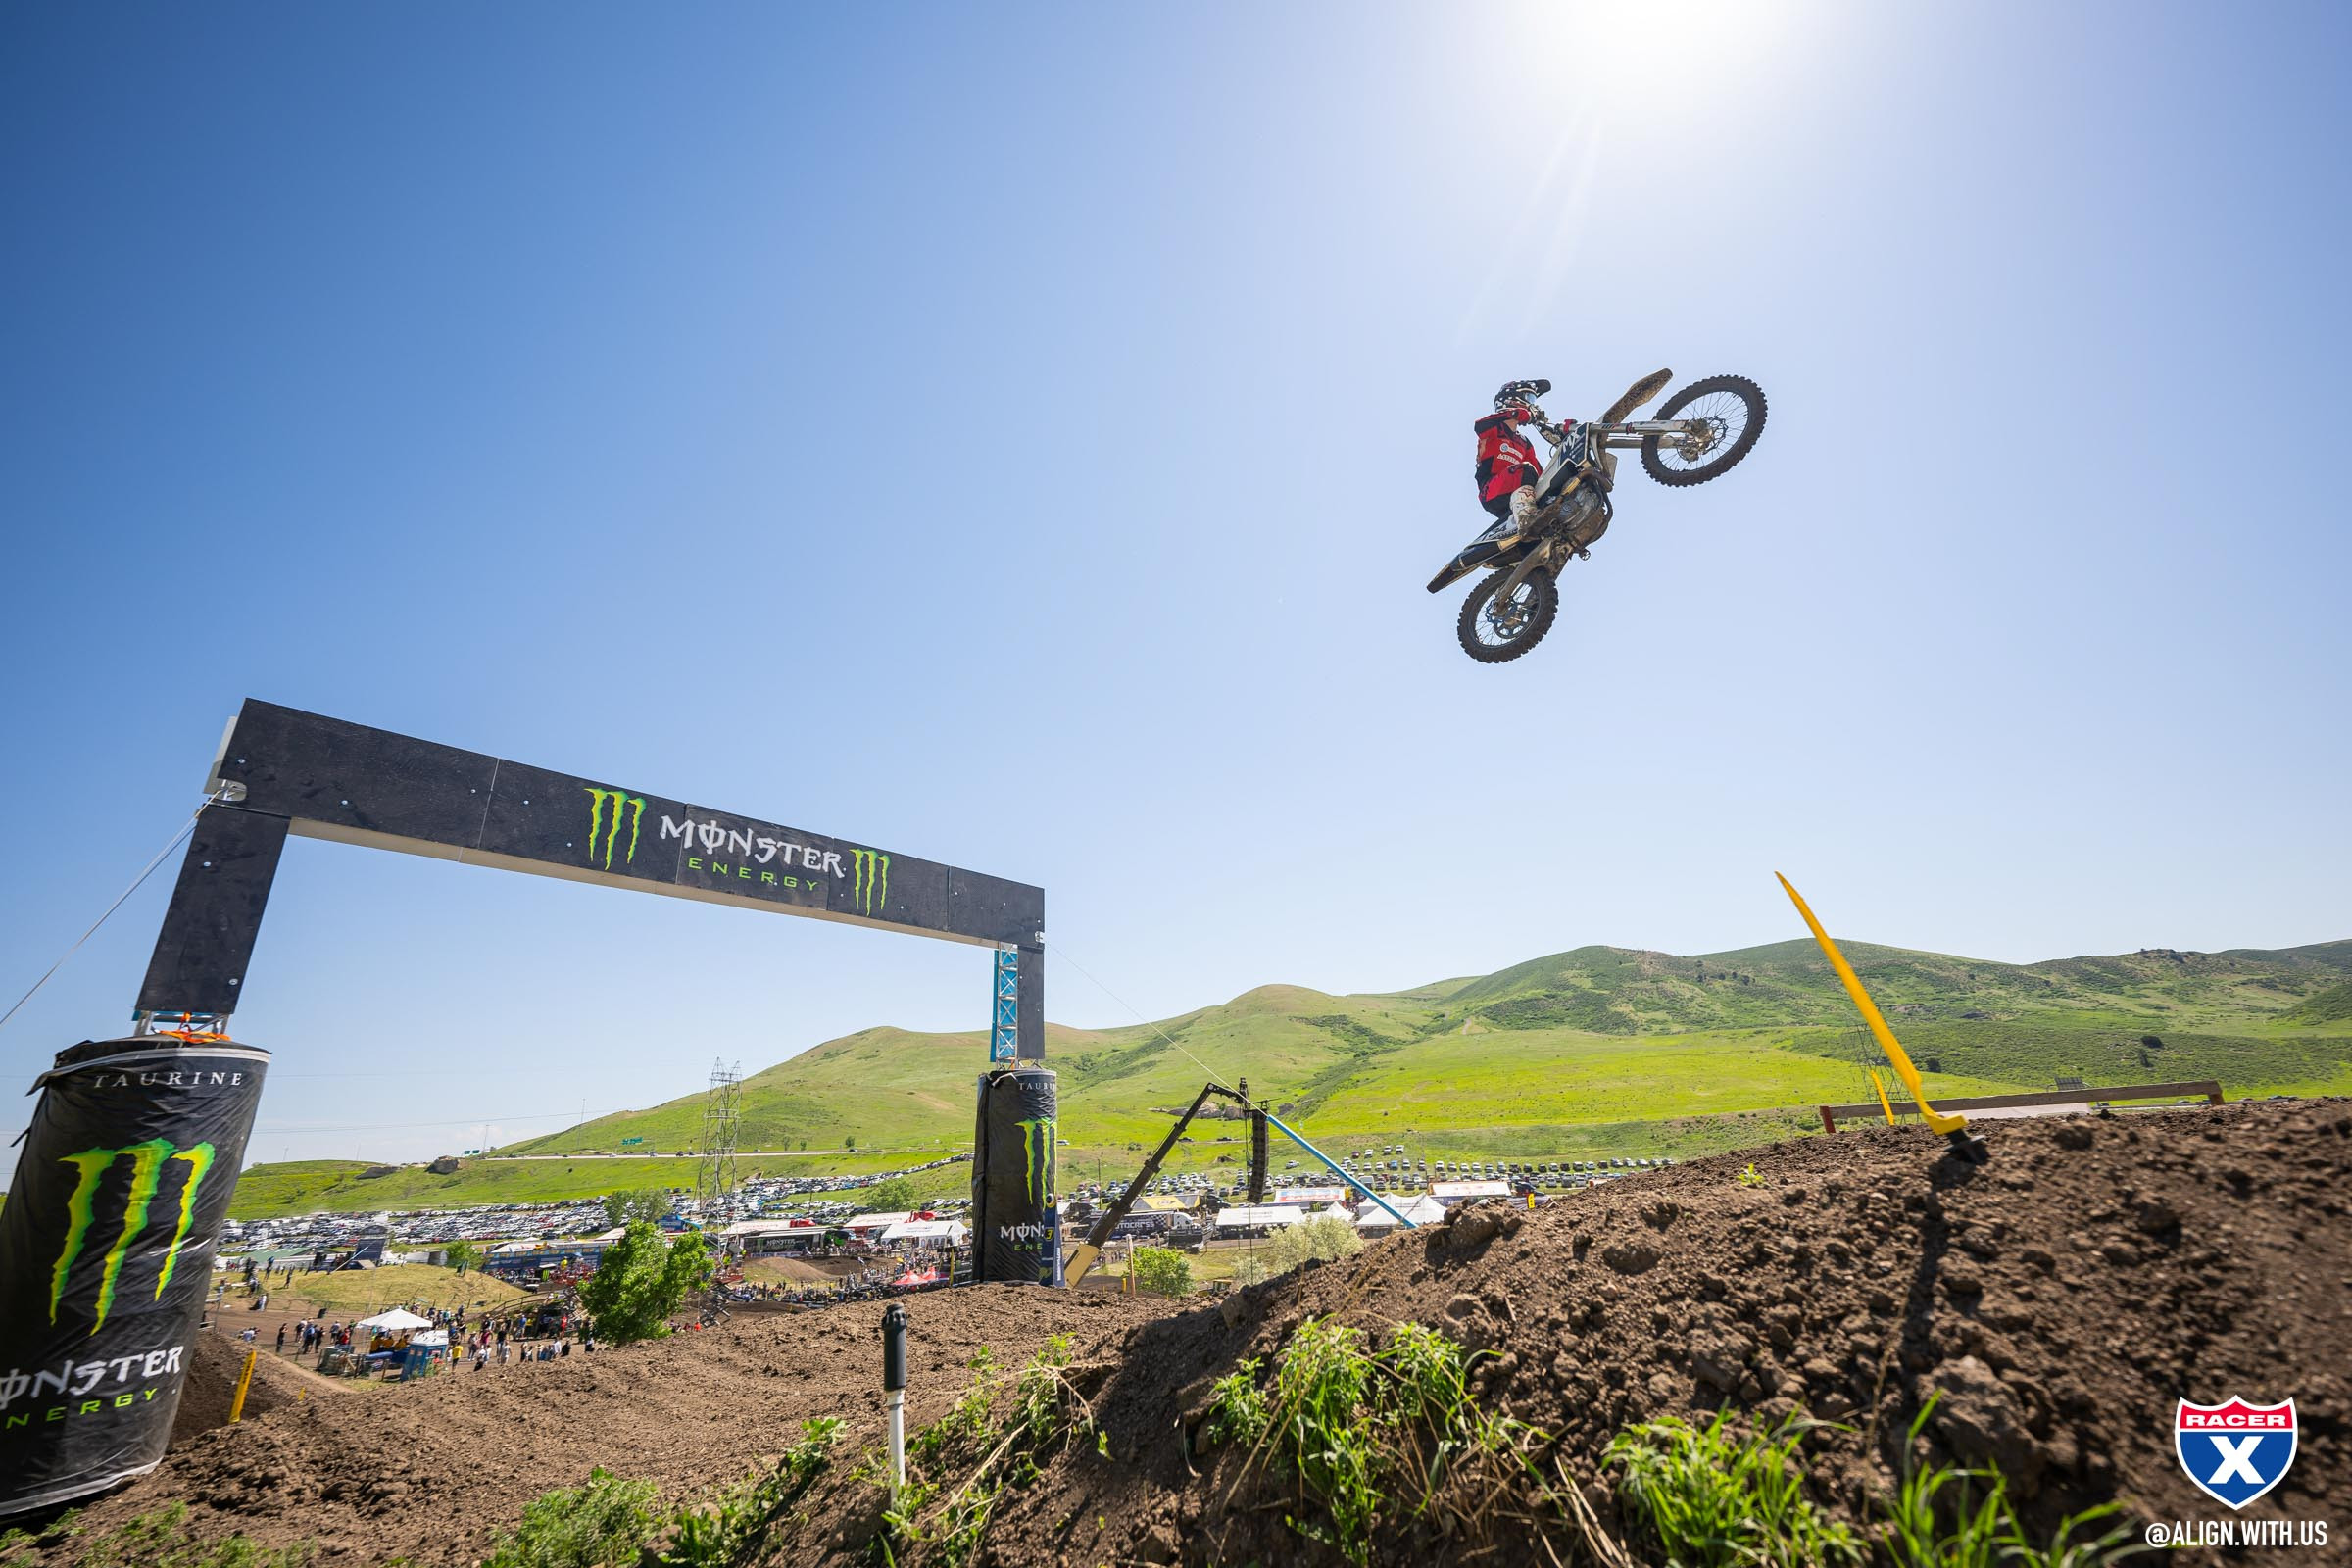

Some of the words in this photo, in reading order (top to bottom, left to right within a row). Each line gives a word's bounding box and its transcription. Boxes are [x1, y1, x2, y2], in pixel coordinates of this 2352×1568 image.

[660, 815, 845, 878] MONSTER
[688, 857, 818, 891] ENERGY
[93, 1071, 242, 1089] TAURINE
